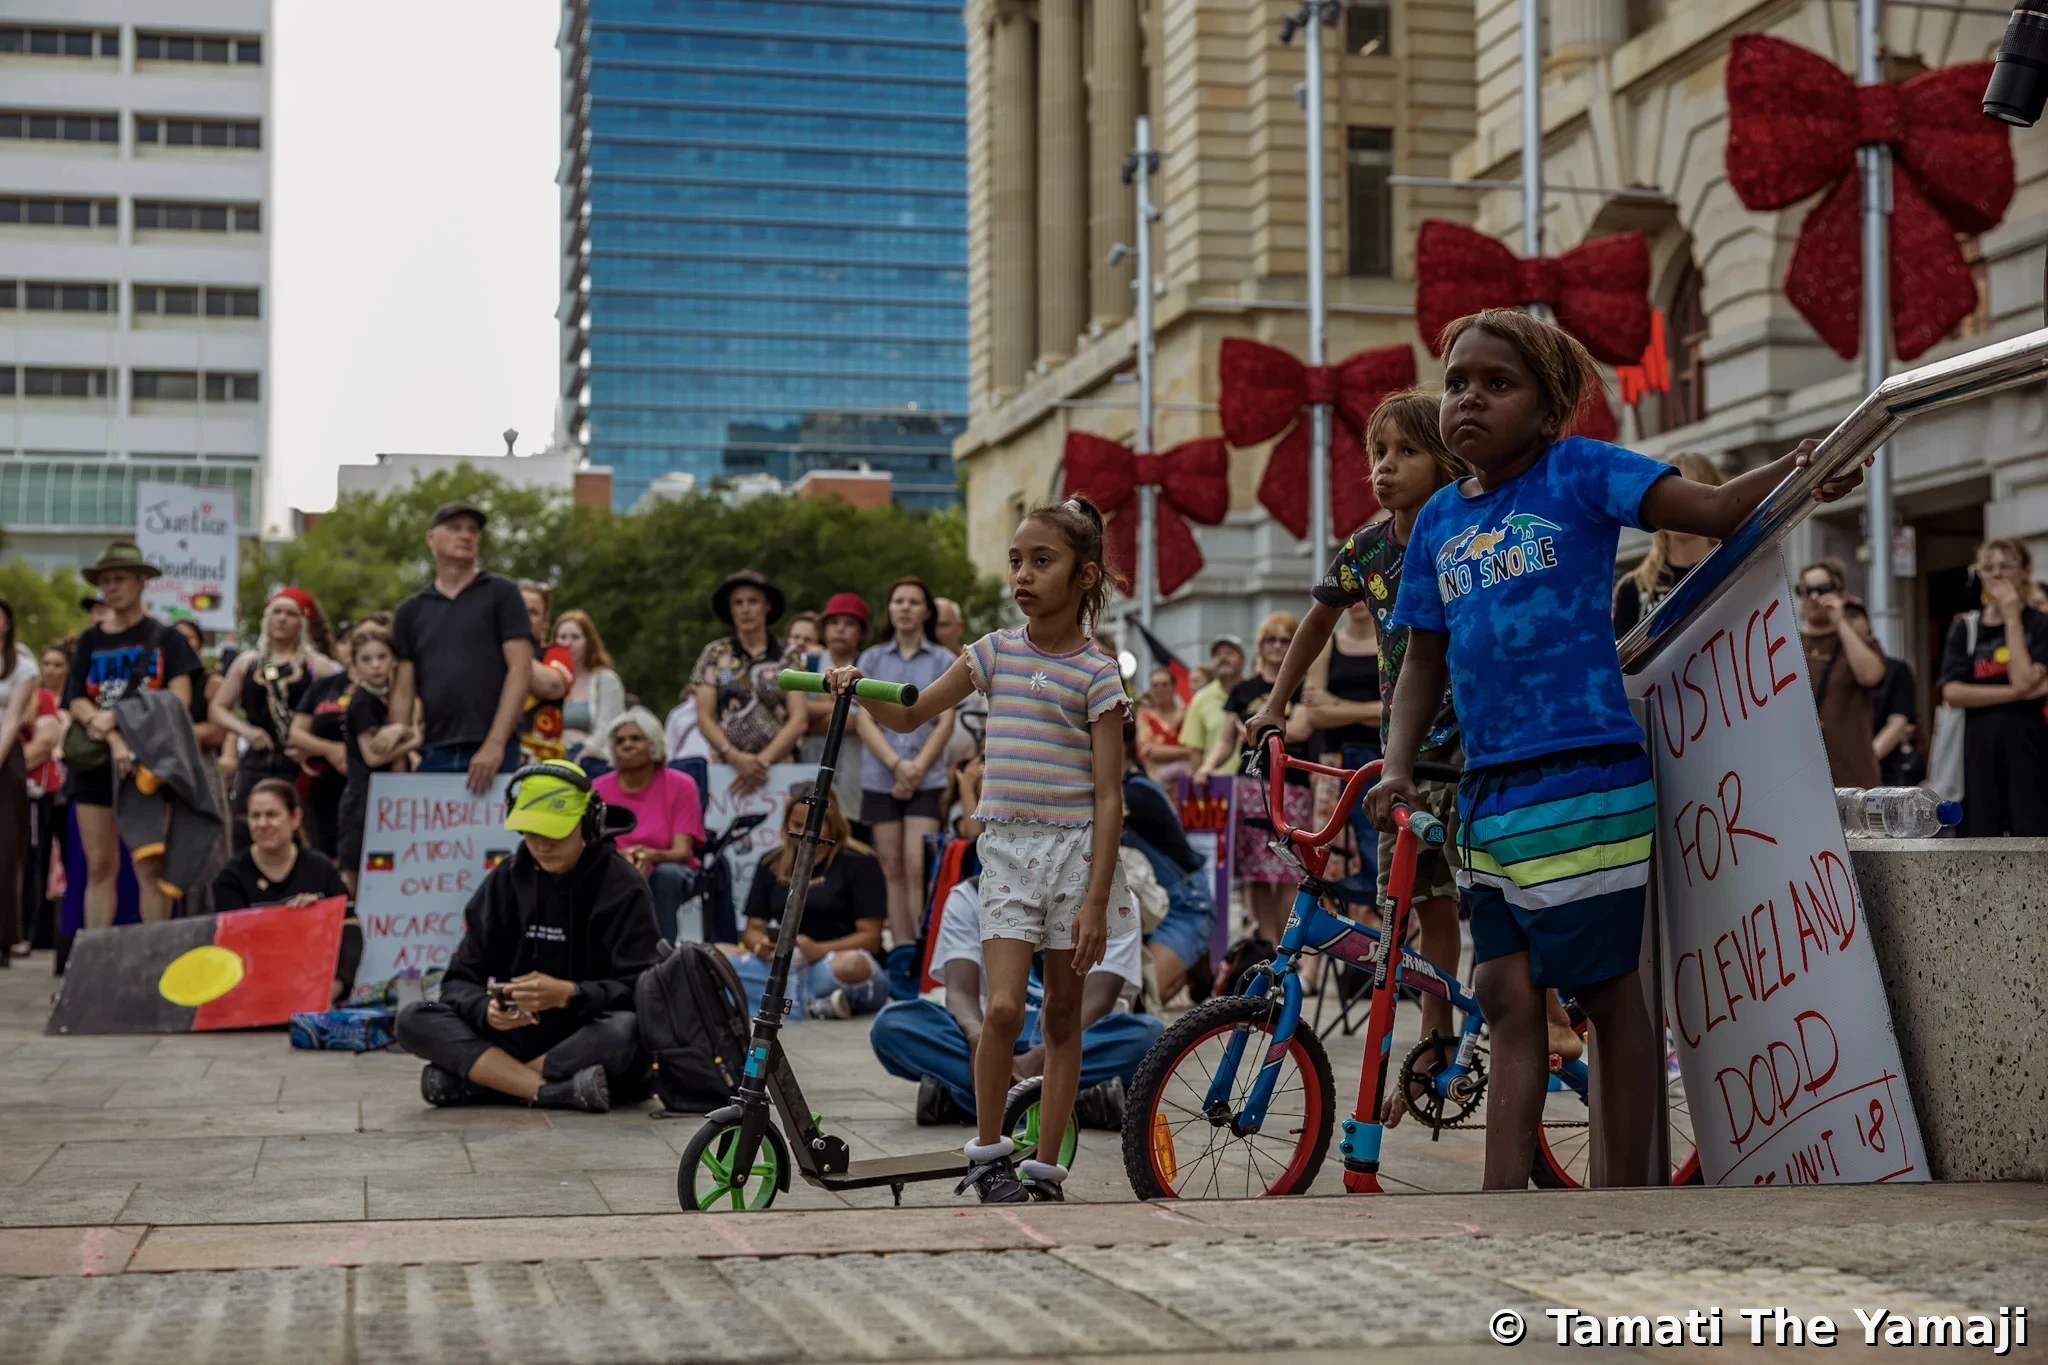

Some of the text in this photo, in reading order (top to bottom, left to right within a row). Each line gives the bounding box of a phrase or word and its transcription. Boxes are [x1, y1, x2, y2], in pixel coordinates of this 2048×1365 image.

[1359, 540, 1385, 566] HULK
[1438, 563, 1473, 605] INO
[1479, 536, 1557, 588] SNORE
[1642, 599, 1798, 759] USTICE
[401, 836, 475, 865] ATION
[1674, 770, 1778, 887] FOR
[401, 868, 475, 896] OVER
[392, 944, 460, 969] ATIO
[1357, 941, 1438, 980] SER-MAN
[1674, 850, 1856, 1049] CLEVELAND
[1714, 1010, 1839, 1153] DODD
[1855, 1098, 1885, 1153] 18
